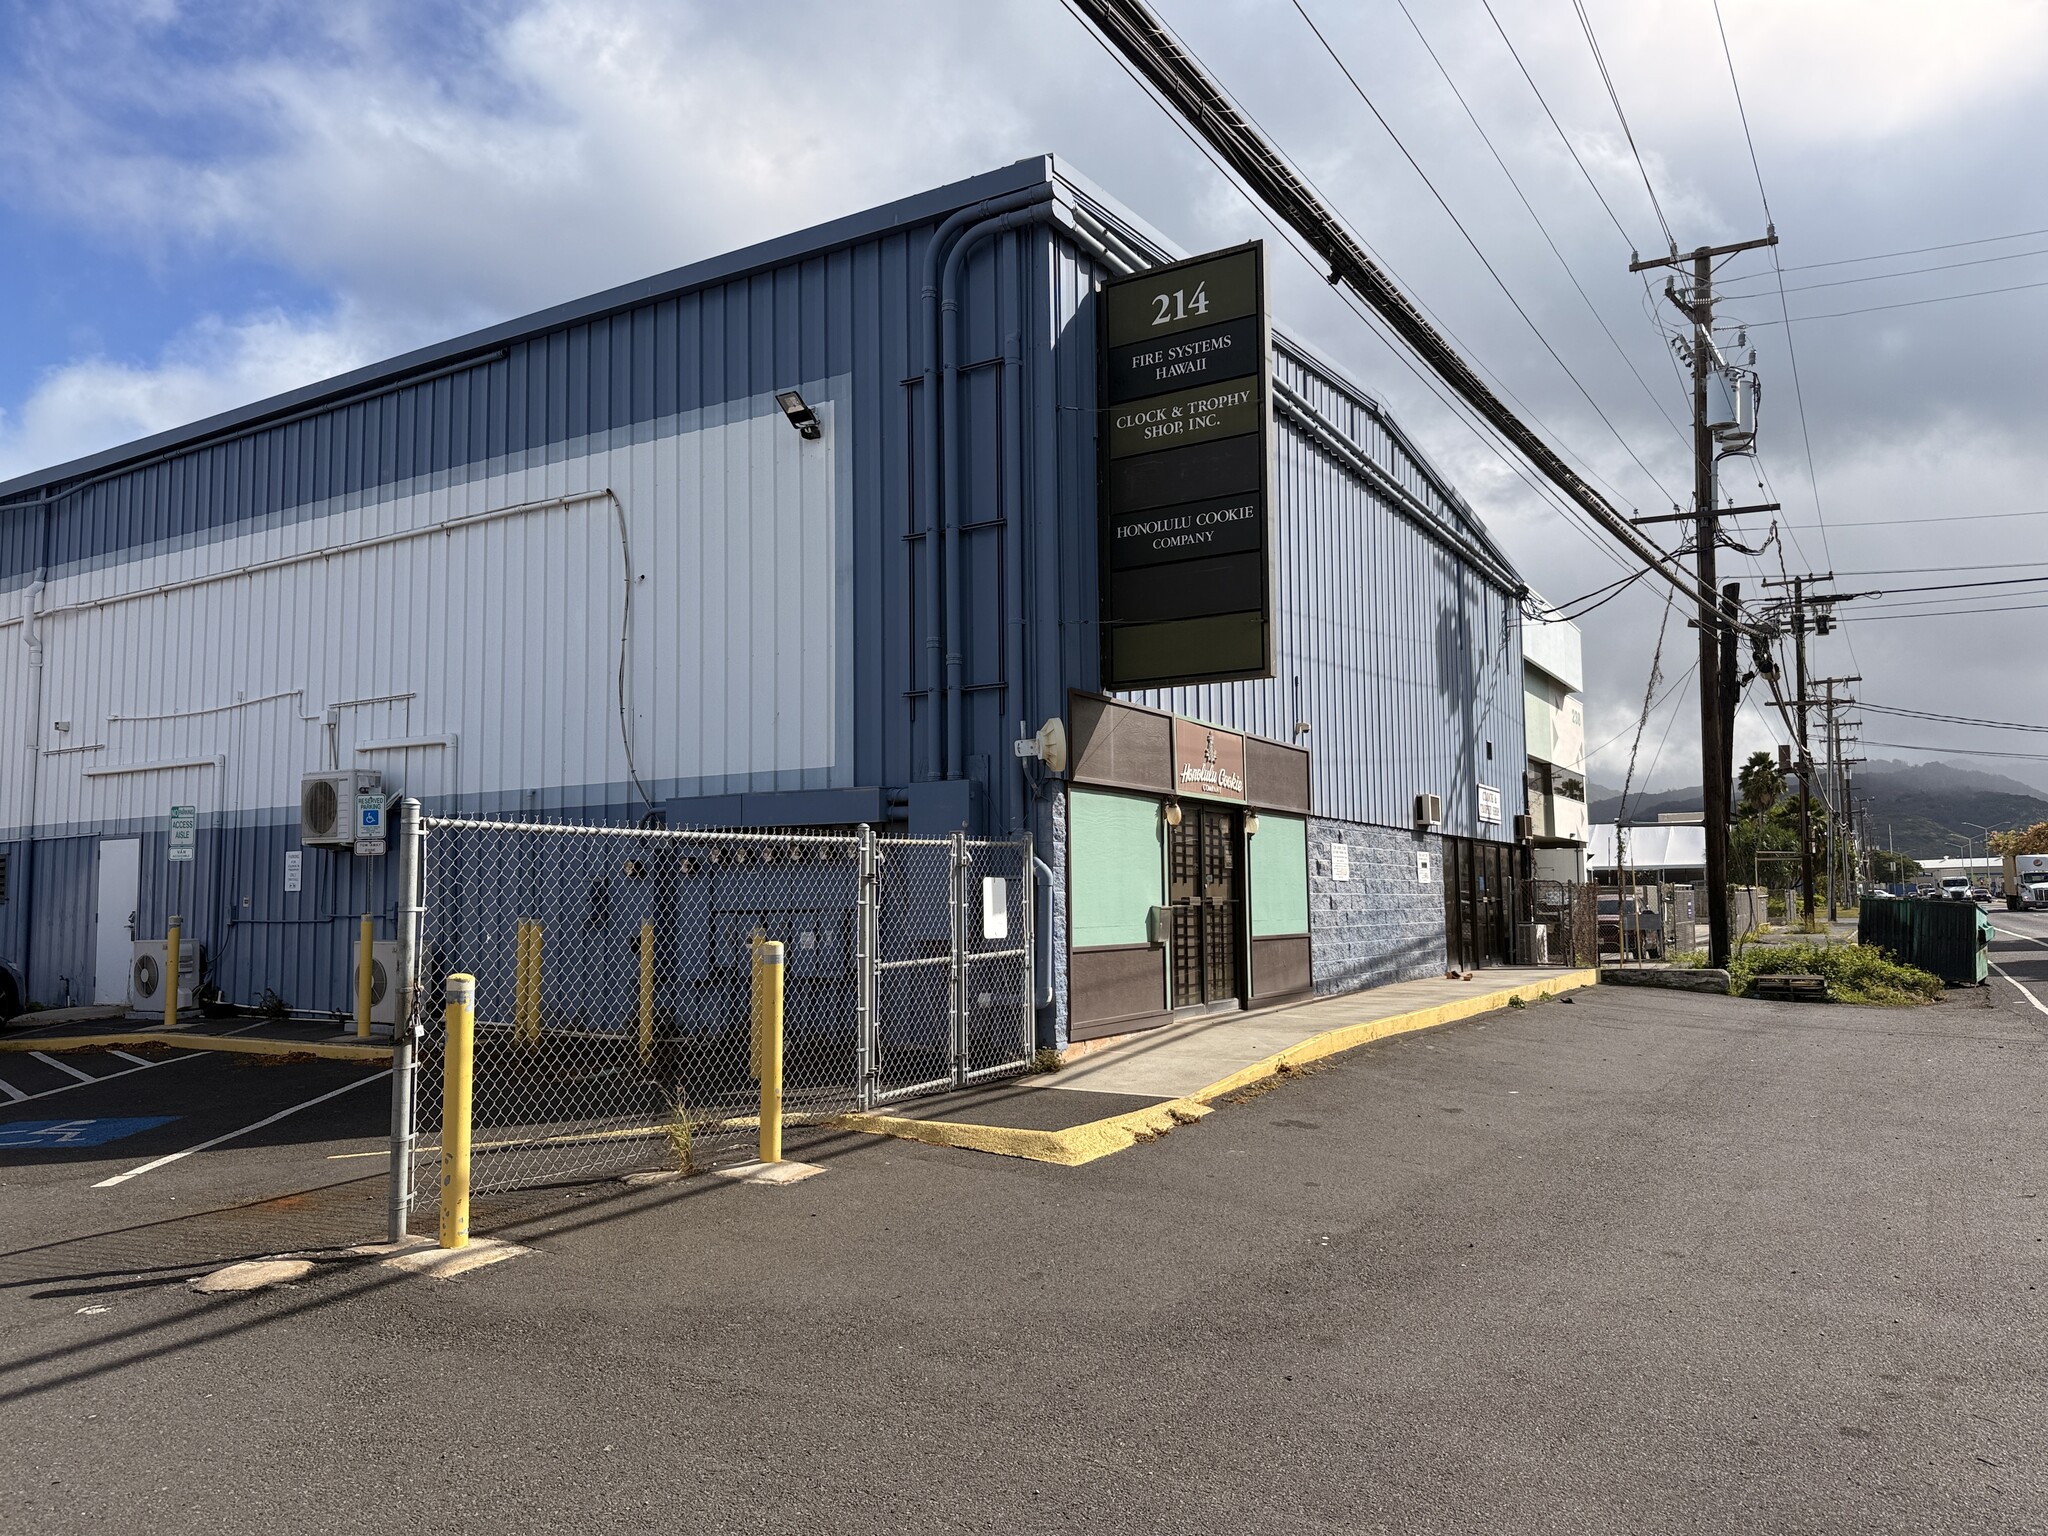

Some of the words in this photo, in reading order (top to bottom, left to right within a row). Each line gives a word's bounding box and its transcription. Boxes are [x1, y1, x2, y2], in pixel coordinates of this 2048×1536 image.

[1151, 280, 1210, 326] 214
[1132, 350, 1163, 369] FIRE
[1168, 334, 1232, 361] SYSTEMS
[1155, 357, 1207, 380] HAWAII
[1116, 407, 1167, 429] CLOCK
[1171, 406, 1183, 418] &
[1187, 390, 1250, 415] TROPHY
[1144, 421, 1183, 439] SHOP,
[1188, 413, 1221, 430] INC.
[1117, 515, 1192, 539] HONOLULU
[1196, 505, 1254, 526] COOKIE
[1152, 530, 1214, 549] COMPANY
[1180, 763, 1218, 784] Honolulu
[1218, 768, 1244, 793] Cookie
[173, 821, 193, 829] ACCESS
[175, 831, 190, 839] AISLE
